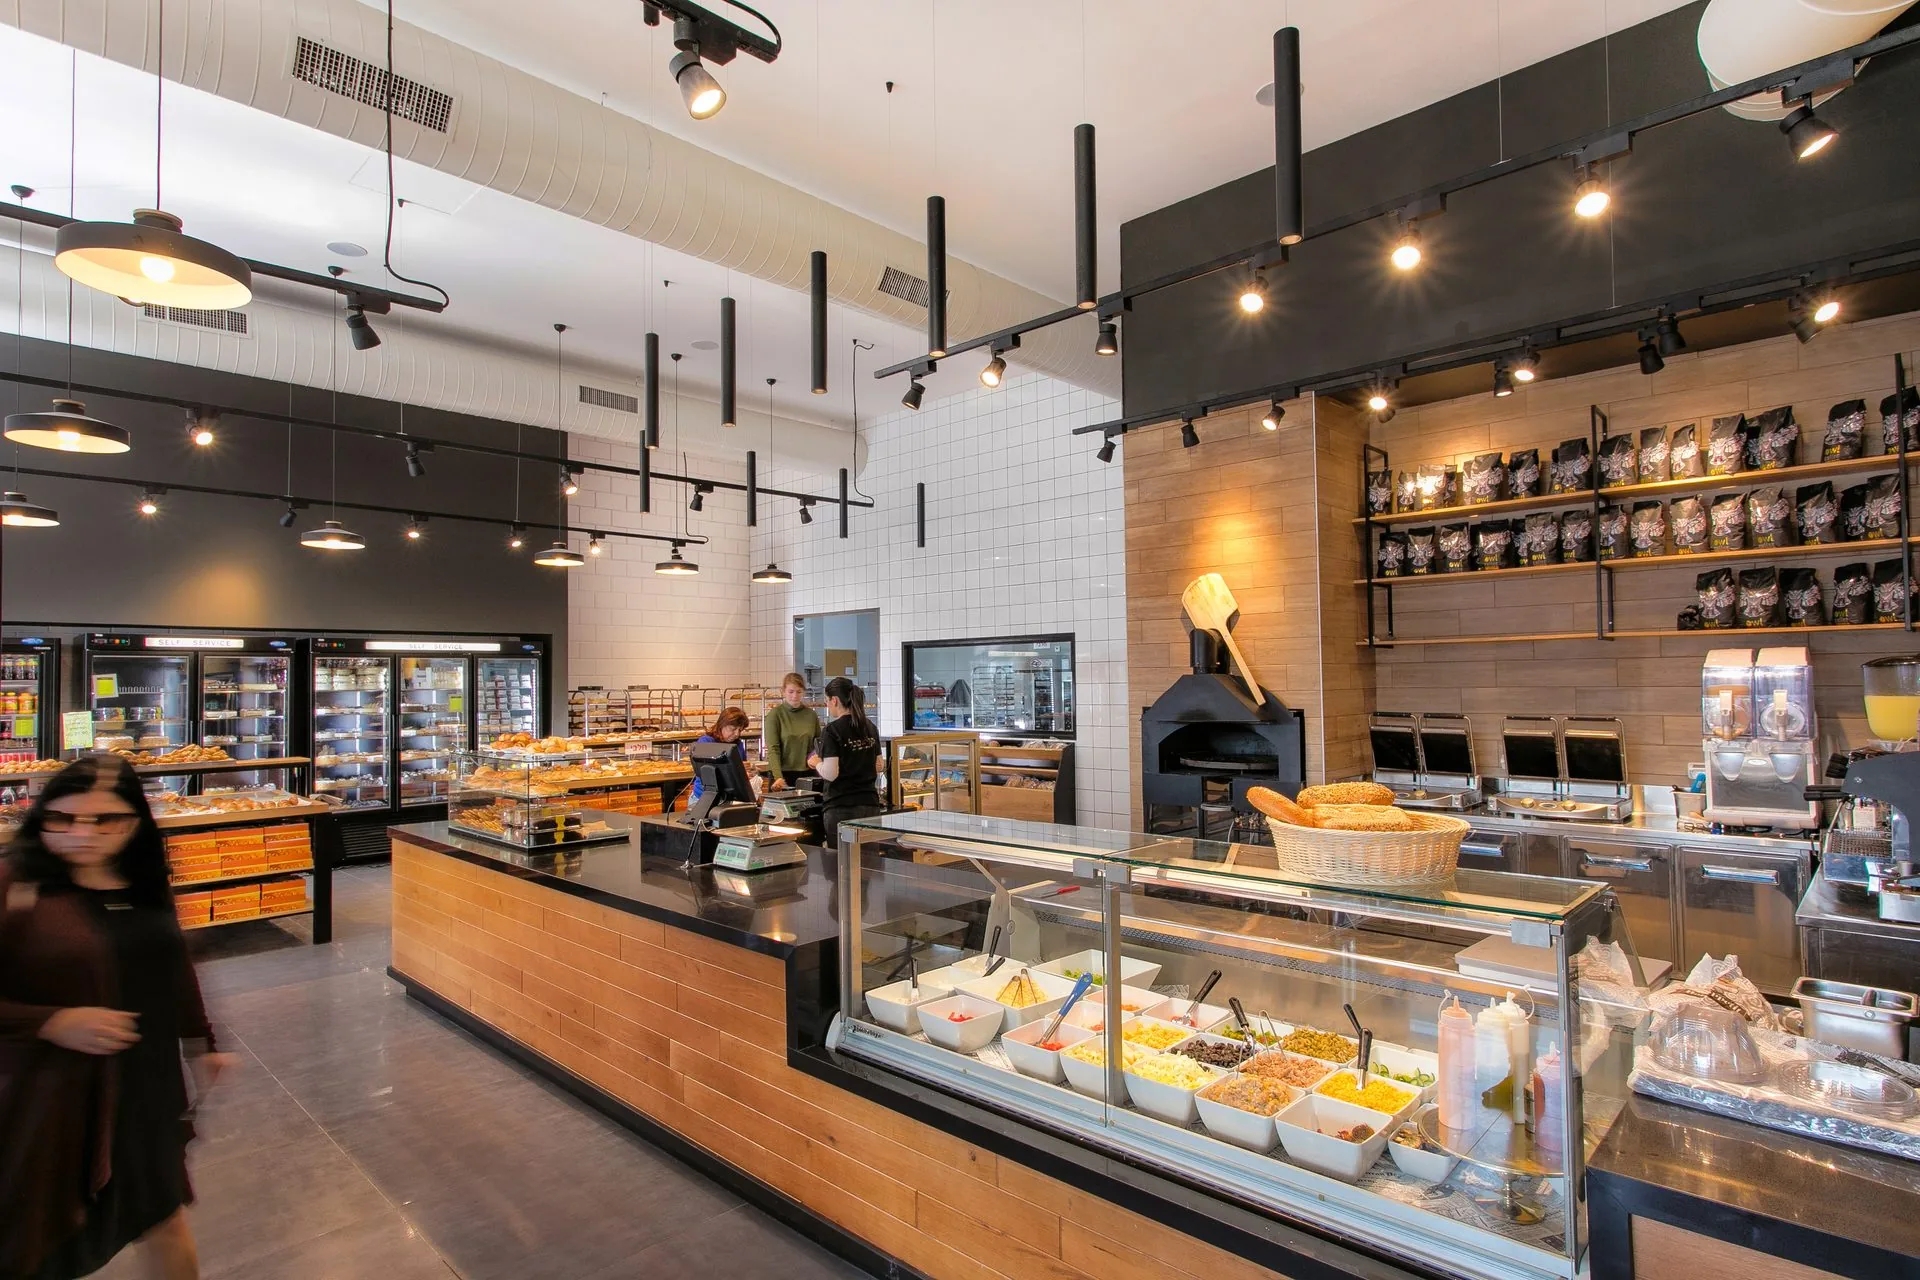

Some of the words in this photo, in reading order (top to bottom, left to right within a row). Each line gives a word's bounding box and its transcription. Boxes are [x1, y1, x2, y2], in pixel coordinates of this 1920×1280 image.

[1714, 537, 1729, 545] owl
[1757, 533, 1774, 543] owl
[1449, 560, 1463, 568] owl
[1745, 618, 1763, 627] owl
[630, 744, 648, 752] חלבי
